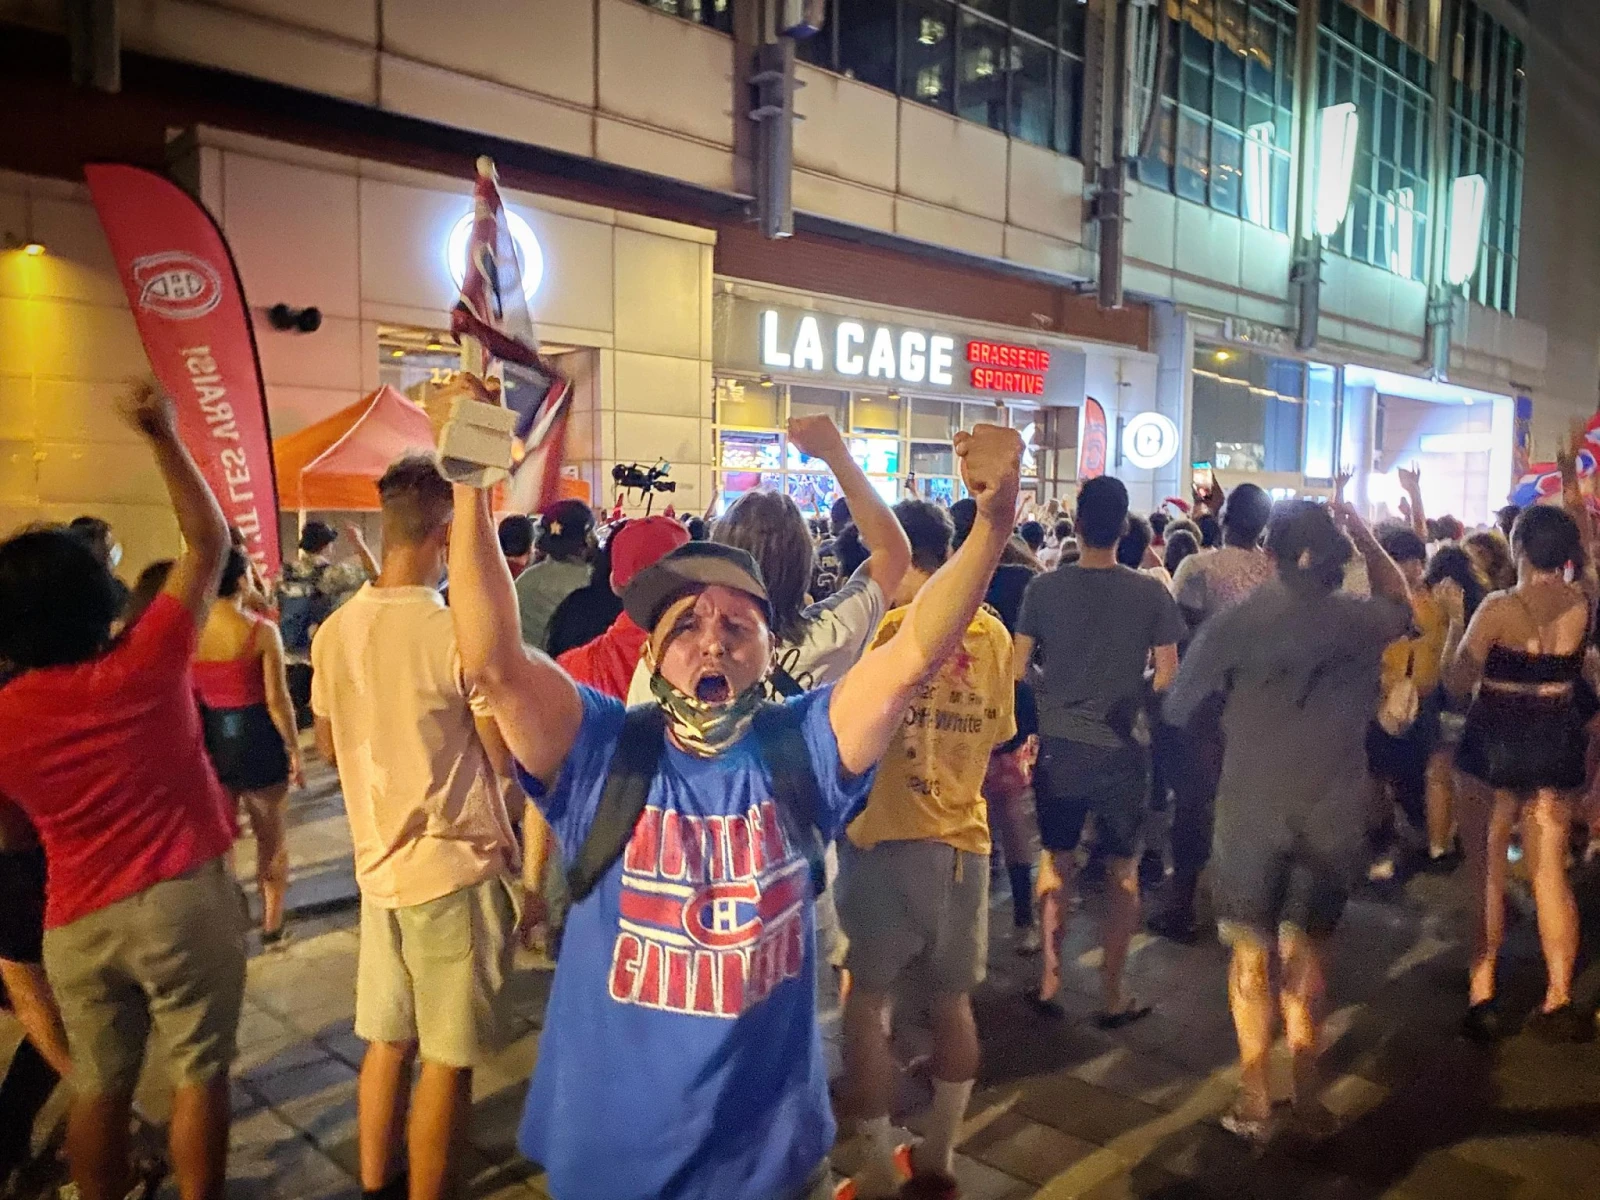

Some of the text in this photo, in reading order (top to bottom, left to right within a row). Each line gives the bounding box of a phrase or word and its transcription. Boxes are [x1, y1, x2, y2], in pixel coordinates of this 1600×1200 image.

[761, 309, 955, 385] LA CAGE
[968, 340, 1050, 372] BRASSERIE
[970, 366, 1045, 395] SPORTIVE
